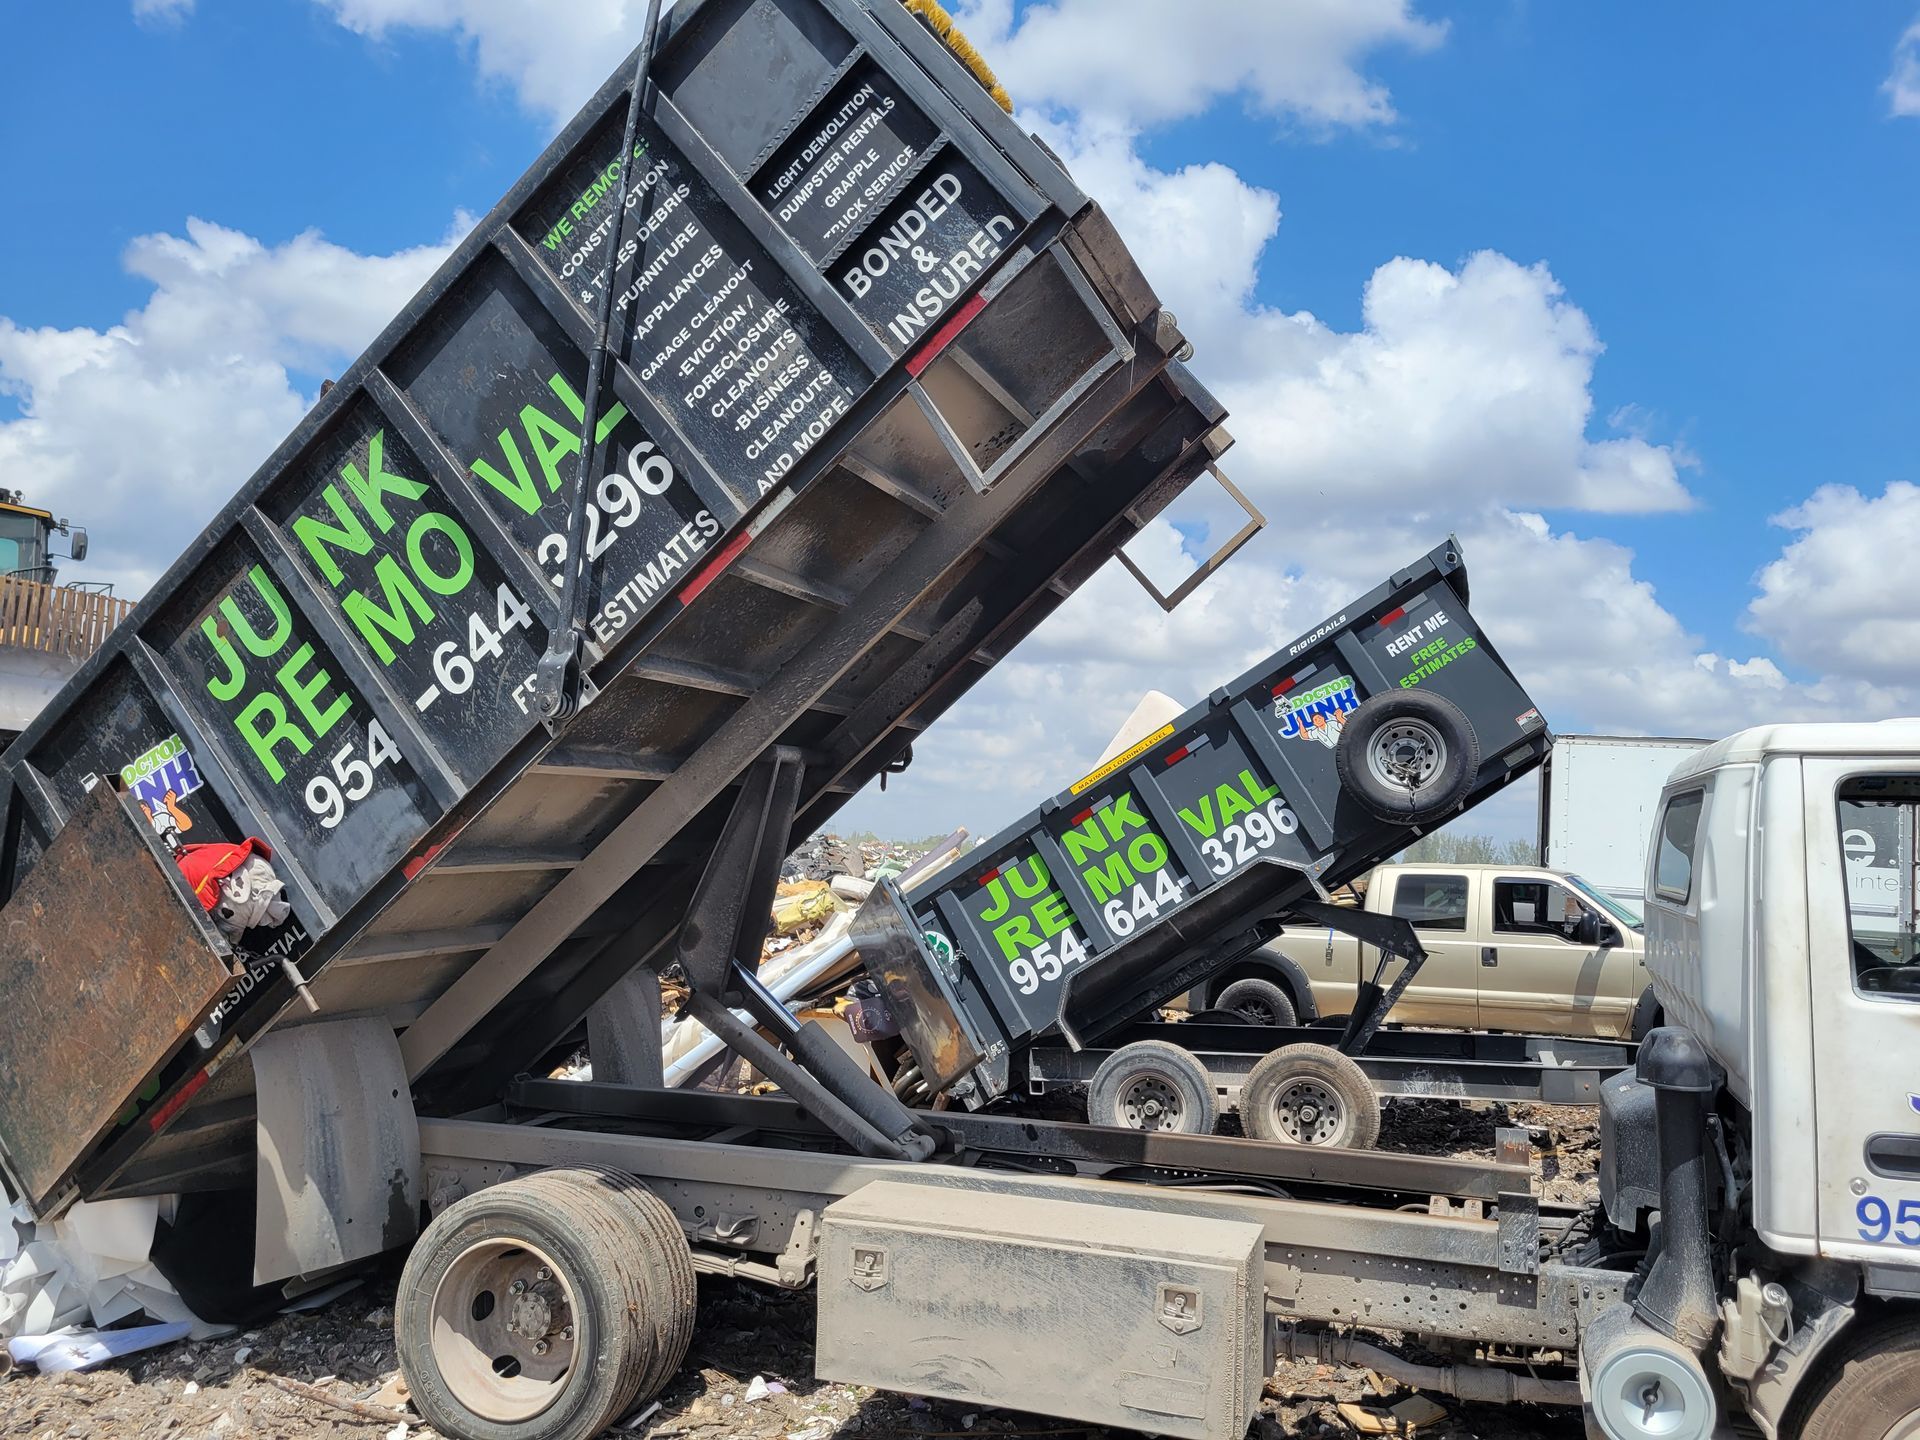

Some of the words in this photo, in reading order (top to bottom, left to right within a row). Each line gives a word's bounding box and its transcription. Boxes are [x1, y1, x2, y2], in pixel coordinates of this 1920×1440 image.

[767, 158, 803, 200] LIGHT
[801, 83, 874, 163] DEMOLITION
[779, 151, 844, 222] DUMPSTER
[840, 96, 895, 155] RENTALS
[824, 147, 880, 208] GRAPPLE
[864, 144, 917, 201] SERVICE
[542, 216, 574, 251] WE
[561, 158, 670, 278] CONSTCTION
[580, 290, 595, 304] &
[636, 183, 690, 242] DEBRIS
[842, 173, 962, 299] BONDED
[617, 221, 700, 312] FURNITURE
[635, 243, 724, 341] APPLIANCES
[887, 214, 1016, 345] INSURED
[911, 245, 941, 273] &
[641, 327, 692, 381] GARAGE
[690, 259, 754, 329] CLEANOUT
[678, 304, 747, 378] EVICTION
[684, 297, 790, 409] FORECLOSURE
[711, 328, 797, 418] CLEANOUTS
[735, 353, 810, 431] BUSINESS
[469, 372, 629, 516] VAL
[745, 370, 833, 460] CLEANOUTS
[756, 453, 794, 497] AND
[589, 509, 719, 645] ESTIMATES
[1385, 625, 1424, 658] RENT
[1423, 610, 1449, 633] ME
[1399, 637, 1477, 689] ESTIMATES
[1410, 636, 1449, 666] FREE
[304, 717, 403, 830] 954
[415, 583, 532, 713] -644
[1281, 687, 1360, 737] JUNK
[1291, 677, 1353, 710] DOCTOR
[1077, 766, 1113, 791] MAXIMUM
[1113, 745, 1145, 768] LOADING
[1145, 730, 1168, 748] LEVEL
[1177, 769, 1281, 839] VAL
[1201, 797, 1300, 877] 3296
[1855, 1195, 1920, 1246] 95
